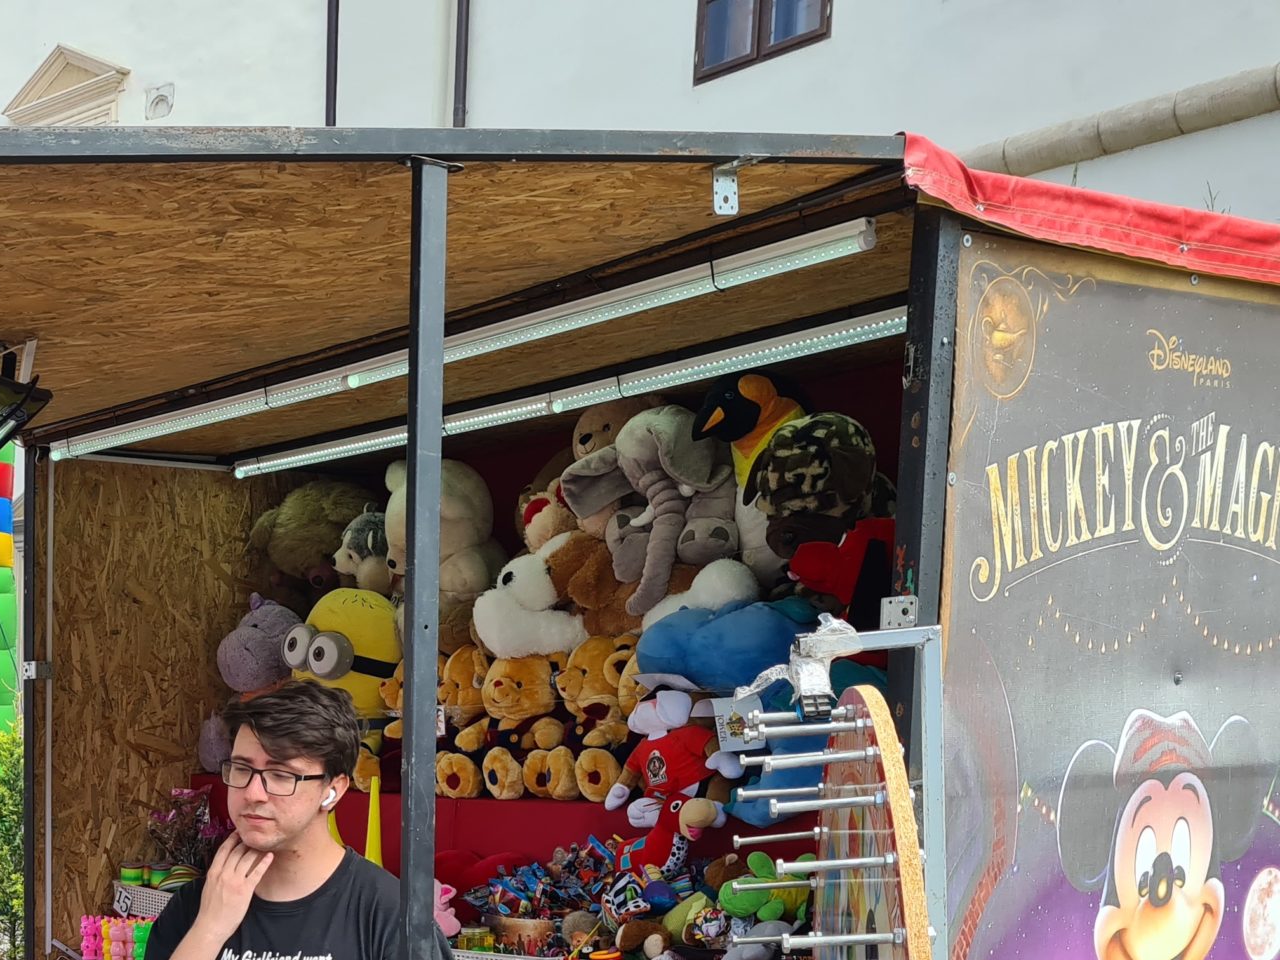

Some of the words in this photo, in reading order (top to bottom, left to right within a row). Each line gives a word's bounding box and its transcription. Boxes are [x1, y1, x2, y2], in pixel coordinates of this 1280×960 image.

[1200, 378, 1231, 389] PARIS
[970, 418, 1142, 601] MICKEY
[1191, 411, 1216, 457] THE
[117, 890, 131, 913] 15
